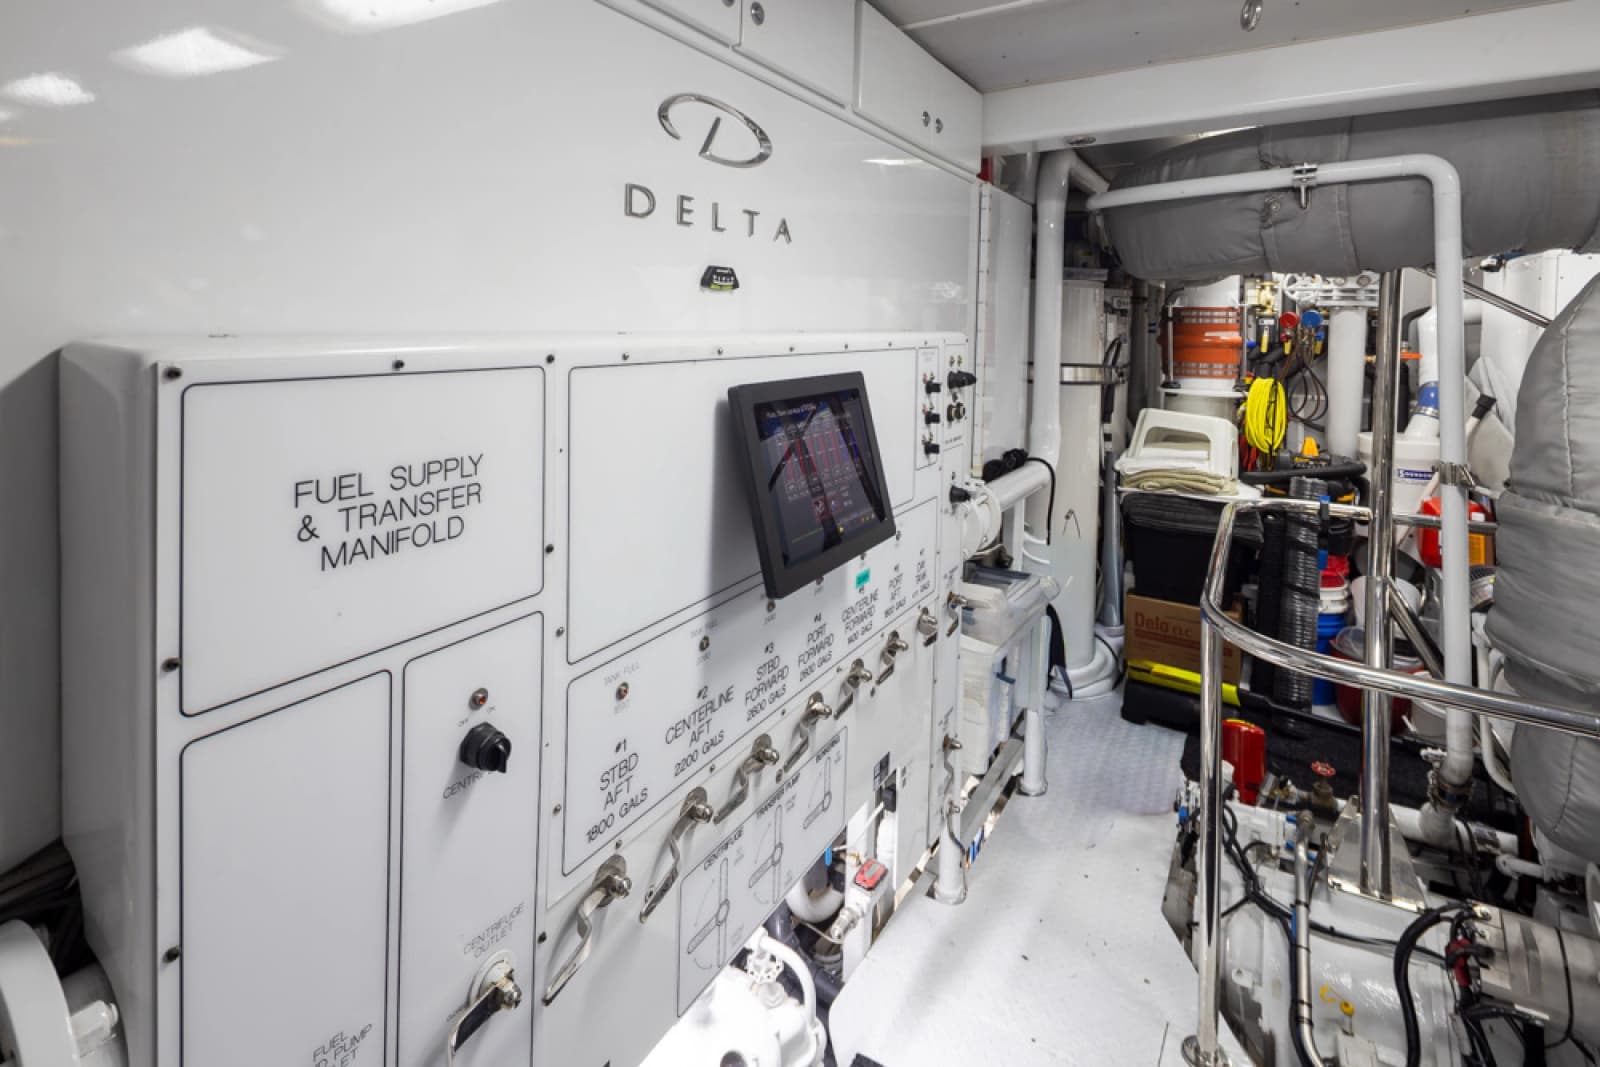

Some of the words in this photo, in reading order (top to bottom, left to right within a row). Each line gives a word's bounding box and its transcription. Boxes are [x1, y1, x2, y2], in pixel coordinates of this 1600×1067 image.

[624, 183, 792, 244] DELTA
[295, 473, 373, 508] FUEL
[390, 453, 483, 491] SUPPLY
[296, 514, 320, 542] &
[338, 482, 482, 533] TRANSFER
[320, 516, 465, 572] MANIFOLD
[841, 588, 879, 623] CENTERLINE
[845, 604, 875, 636] FORWARD
[798, 633, 835, 669] FORWARD
[807, 623, 827, 648] PORT
[744, 665, 789, 707] FORWARD
[756, 655, 780, 681] STBD
[697, 685, 709, 700] #2
[768, 683, 786, 705] GALS
[665, 685, 735, 745] CENTERLINE
[689, 718, 712, 747] AFT
[616, 739, 627, 753] #1
[674, 749, 699, 777] 2200
[702, 730, 725, 755] GALS
[600, 752, 639, 791] STBD
[604, 775, 633, 810] AFT
[586, 813, 615, 844] 1800
[619, 788, 648, 819] GALS
[463, 901, 524, 955] CENTRIFUGE
[473, 920, 513, 958] OUTLET
[313, 1031, 345, 1063] FUEL
[334, 1023, 373, 1060] PUMP
